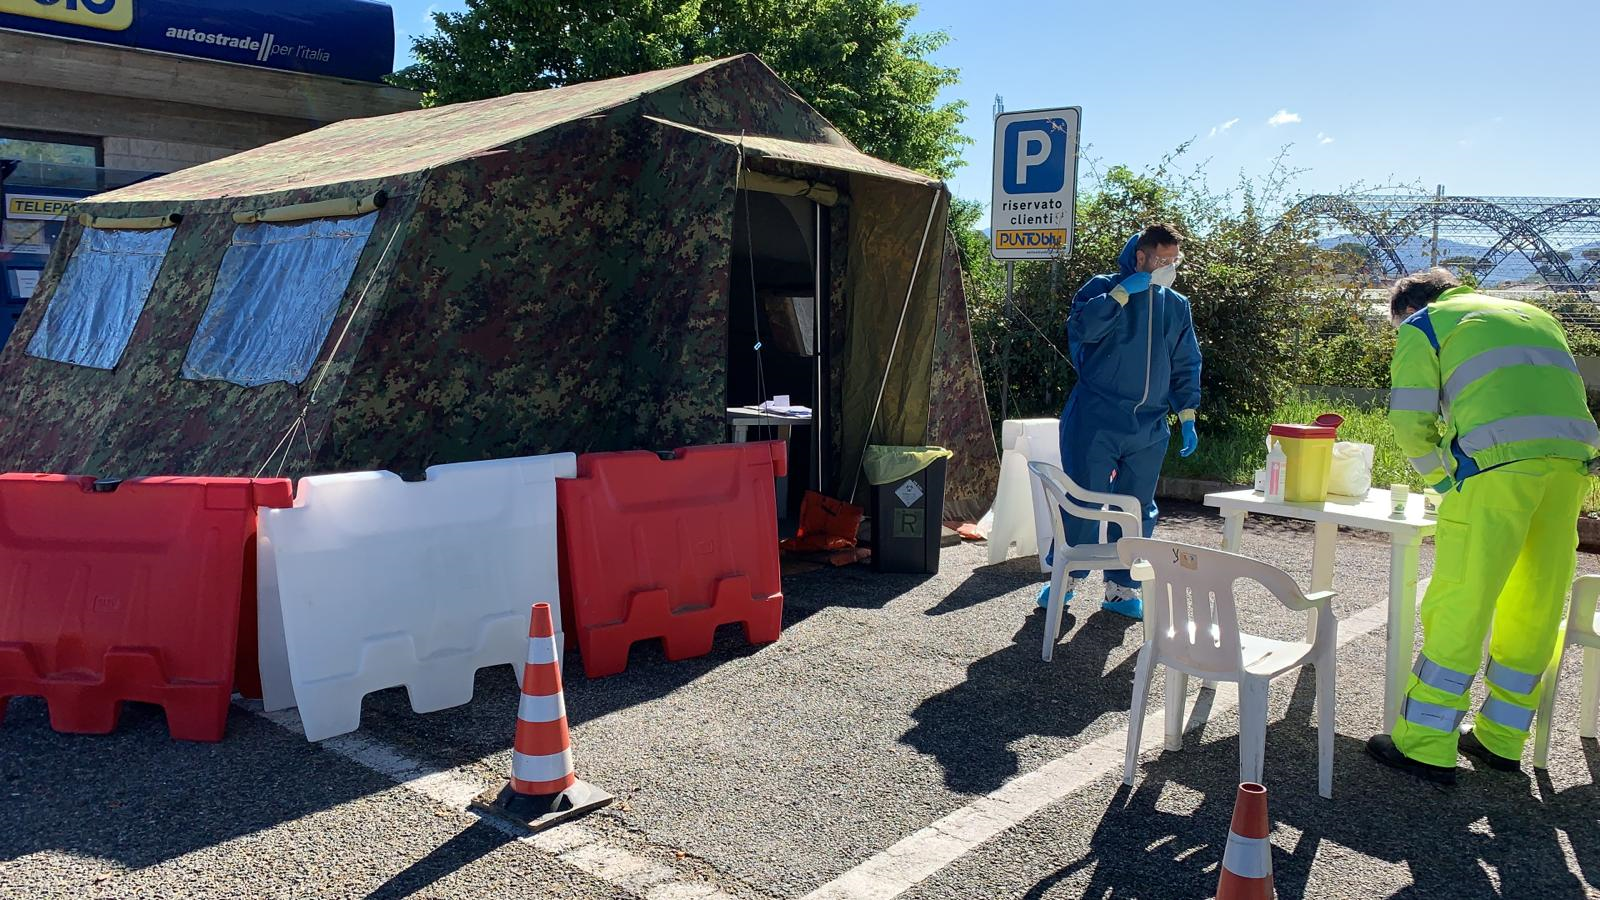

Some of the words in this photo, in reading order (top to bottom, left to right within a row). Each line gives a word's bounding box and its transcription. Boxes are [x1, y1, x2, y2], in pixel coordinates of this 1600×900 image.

[165, 27, 260, 51] autostrade
[270, 43, 292, 57] per
[295, 45, 331, 62] l'italia
[1016, 129, 1052, 185] P
[15, 200, 76, 214] TELEPA
[1002, 198, 1063, 211] riservato
[1010, 213, 1053, 225] clienti
[901, 513, 918, 534] R
